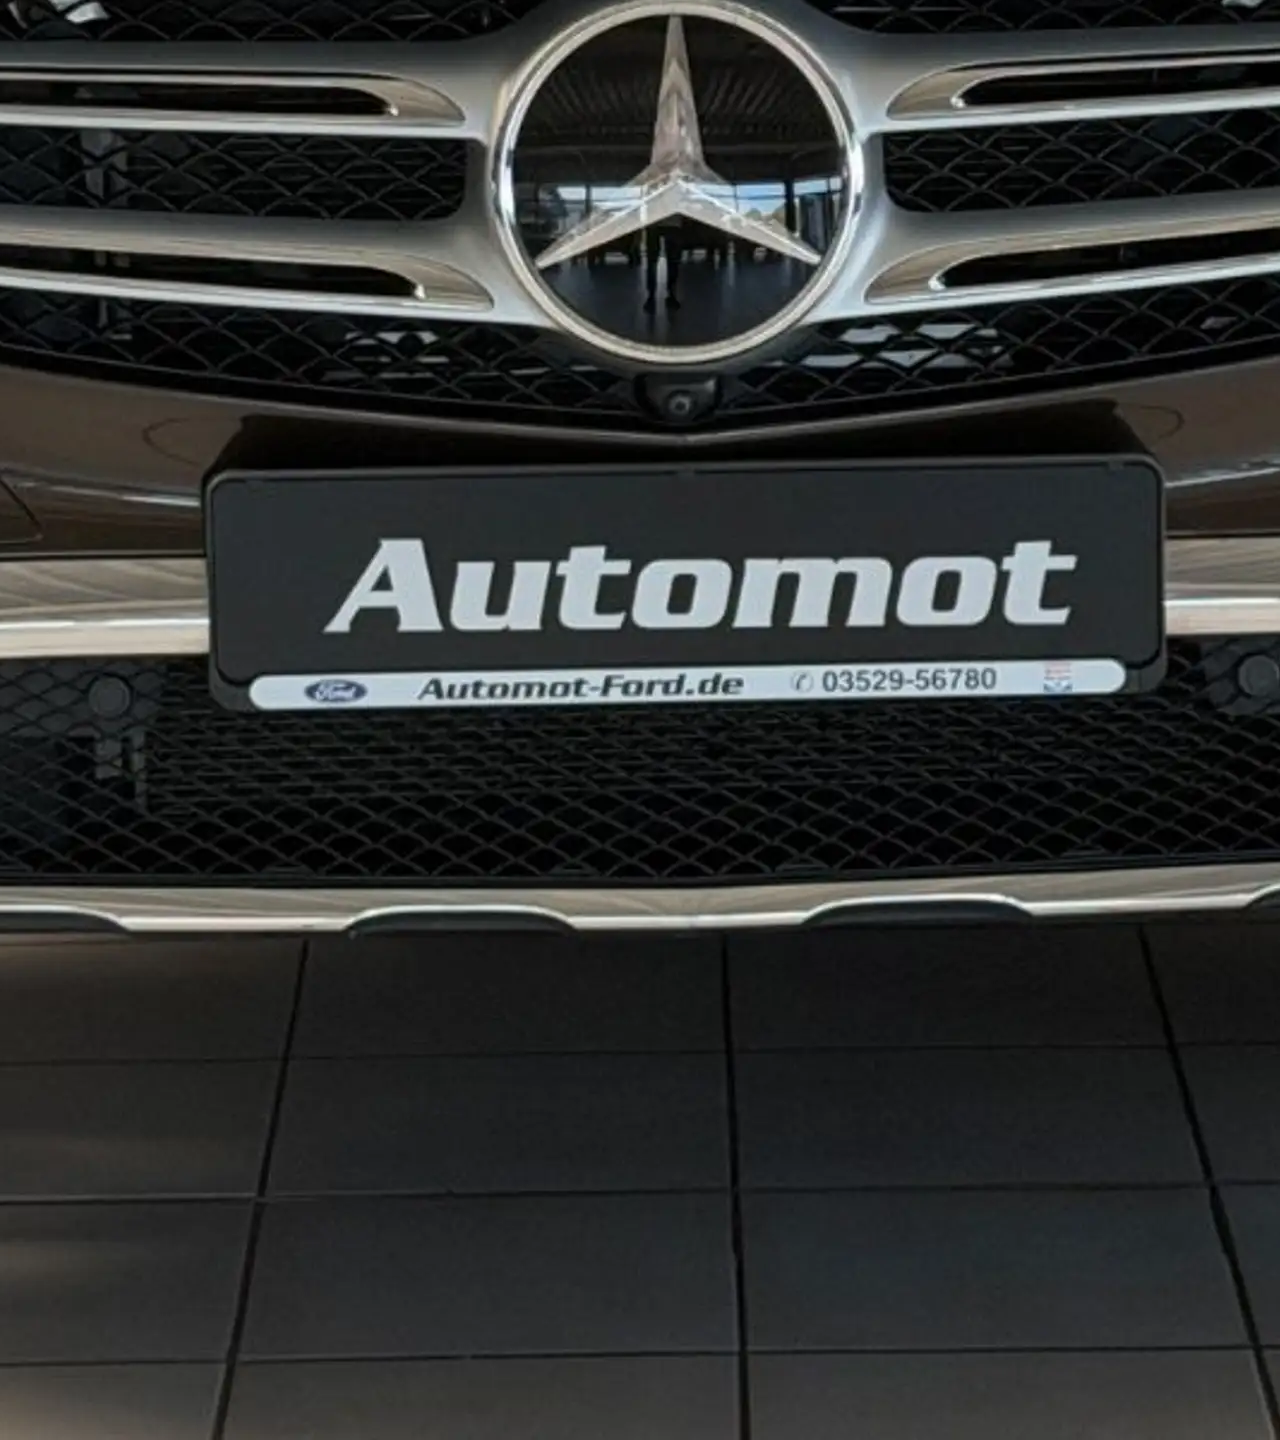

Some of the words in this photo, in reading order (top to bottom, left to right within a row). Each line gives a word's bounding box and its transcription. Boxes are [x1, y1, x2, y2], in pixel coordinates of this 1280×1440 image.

[324, 539, 1077, 632] Automot
[417, 672, 744, 701] Automot-Ford.de
[822, 667, 997, 692] 03529-56780
